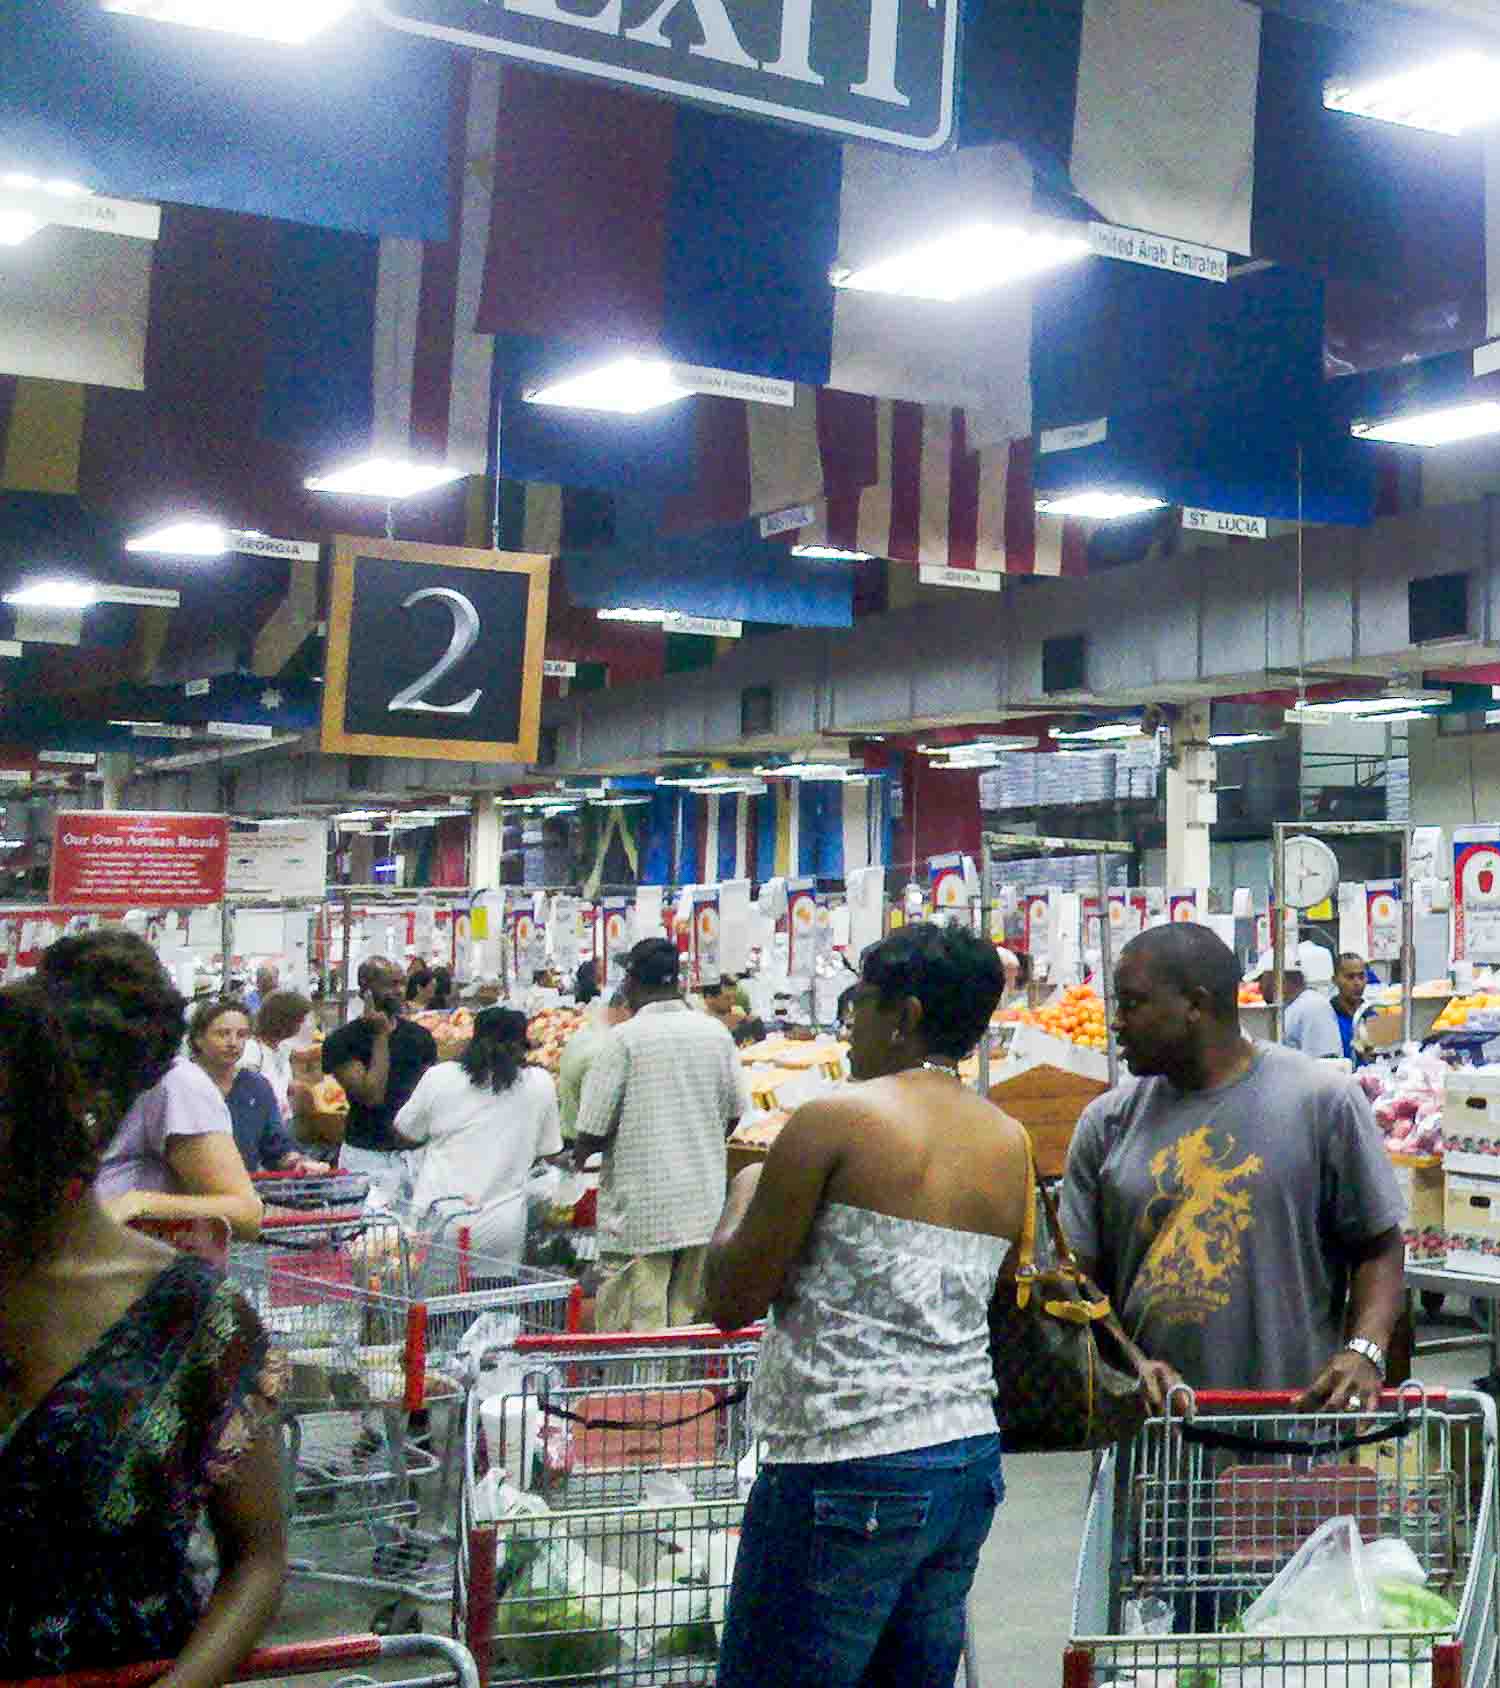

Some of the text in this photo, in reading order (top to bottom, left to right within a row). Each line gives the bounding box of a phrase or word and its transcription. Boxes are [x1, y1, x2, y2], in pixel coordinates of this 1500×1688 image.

[485, 0, 937, 106] XIT
[1138, 239, 1168, 264] Arab
[1172, 245, 1226, 277] Emirates
[1190, 513, 1260, 534] ST LUCIA
[388, 587, 482, 713] 2
[63, 833, 89, 846] Our
[93, 833, 124, 846] Own
